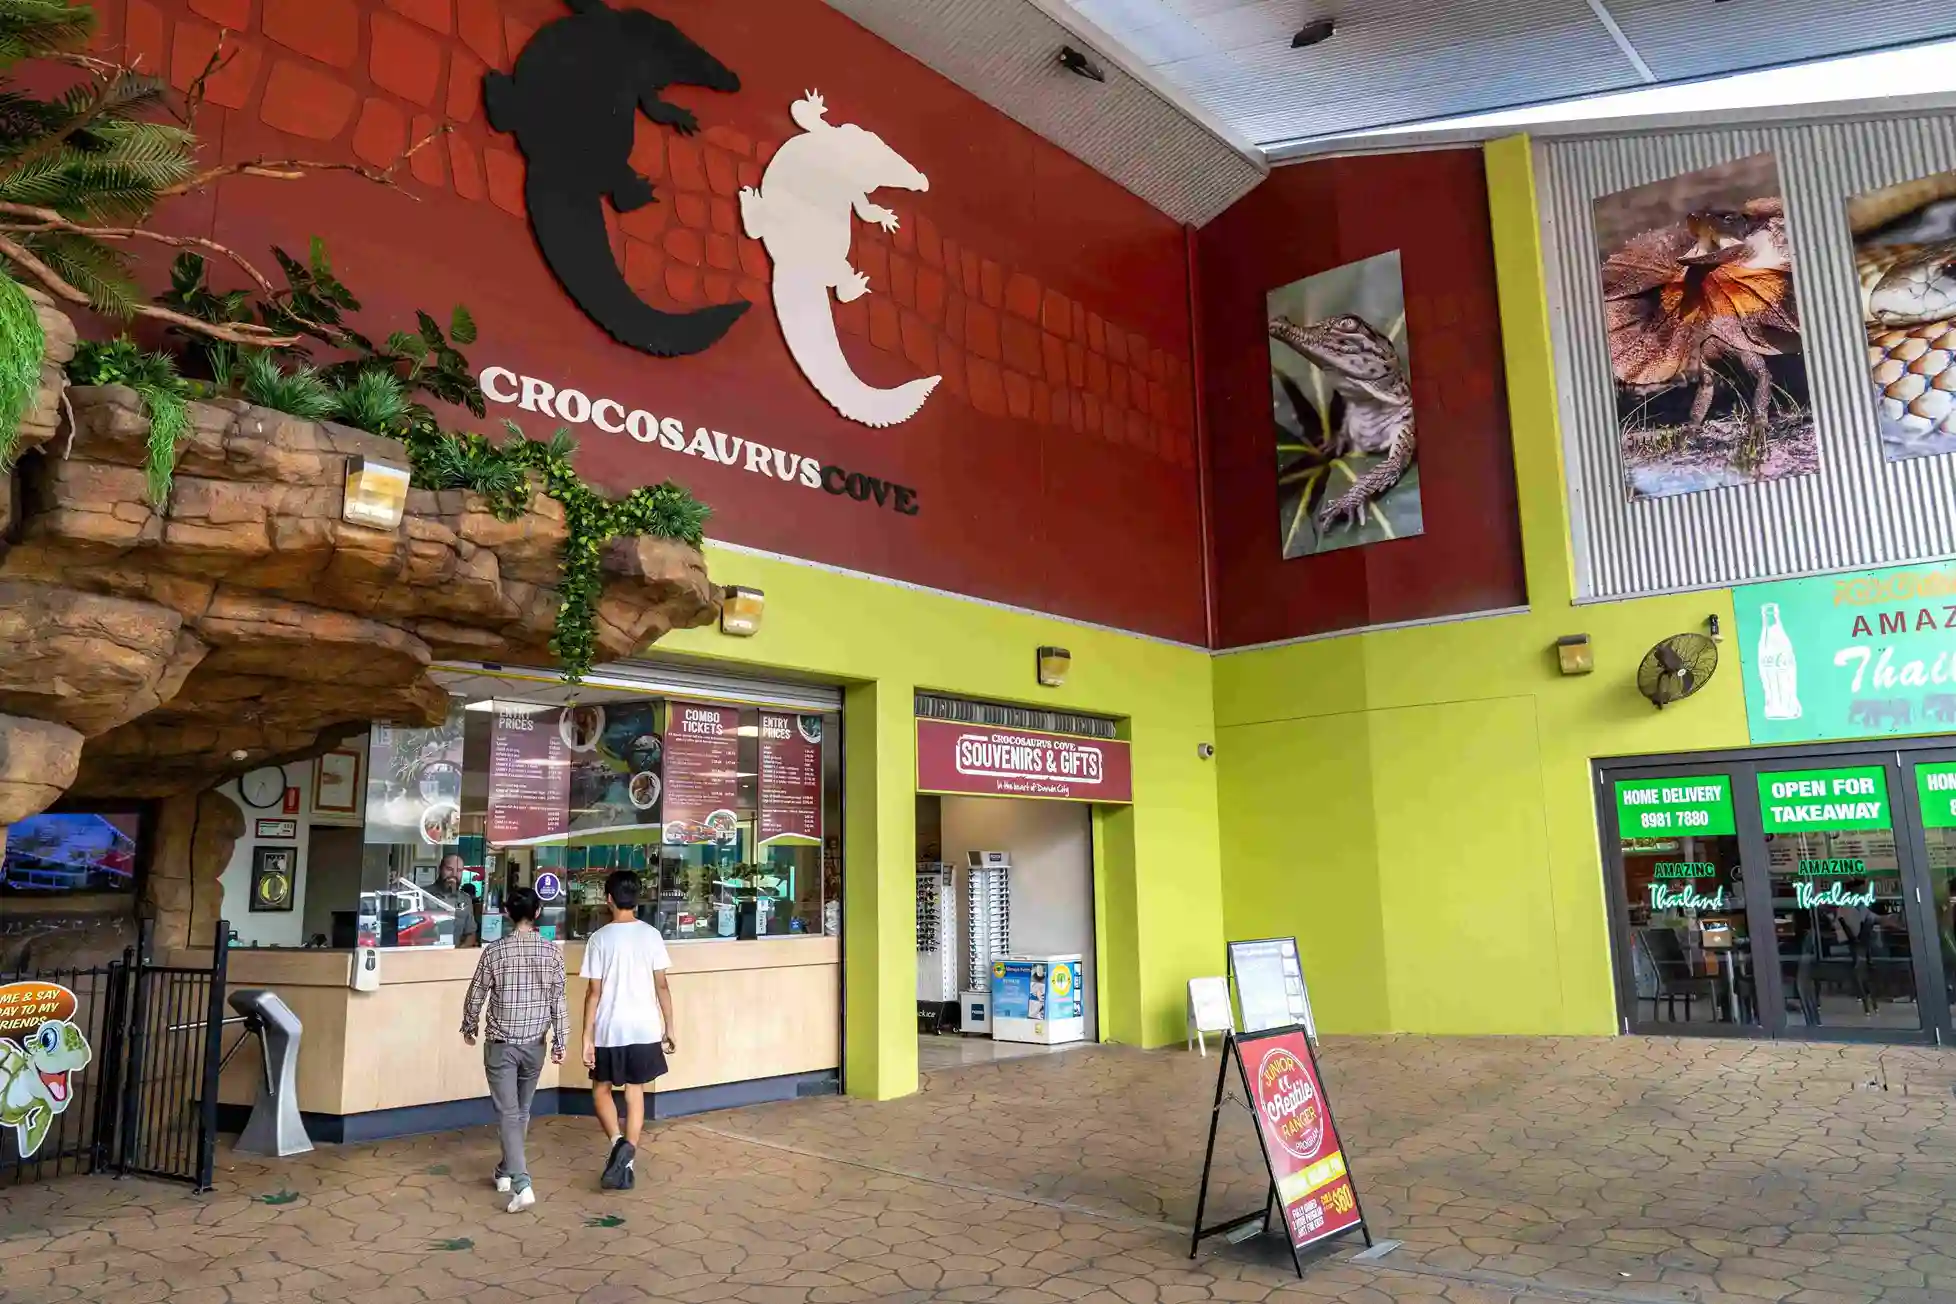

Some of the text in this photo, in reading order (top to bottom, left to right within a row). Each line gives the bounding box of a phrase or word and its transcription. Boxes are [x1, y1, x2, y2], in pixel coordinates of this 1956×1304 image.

[479, 366, 919, 516] CROCOSAURUS COVE
[498, 718, 534, 731] PRICES
[685, 709, 720, 723] COMBO
[762, 716, 789, 729] ENTRY
[681, 720, 723, 735] TICKETS
[762, 727, 791, 740] PRICES
[992, 734, 1076, 752] CROCOSAURUS COVE
[961, 741, 1097, 776] SOUVENIRS & GIFTS
[1623, 785, 1722, 805] HOME DELIVERY
[1771, 778, 1875, 799] OPEN FOR
[1641, 810, 1708, 828] 8981 7880
[1771, 802, 1881, 823] TAKEAWAY
[1654, 862, 1715, 878] AMAZING
[1799, 857, 1866, 875] AMAZING
[1648, 883, 1723, 910] Thailand
[1792, 880, 1876, 909] Thailand
[23, 991, 33, 1002] &
[36, 990, 60, 1001] SAY
[0, 1002, 60, 1017] AY TO MY
[1263, 1057, 1295, 1087] JUNIOR
[1281, 1106, 1317, 1140] RANGER
[1295, 1128, 1320, 1151] PROGRAM
